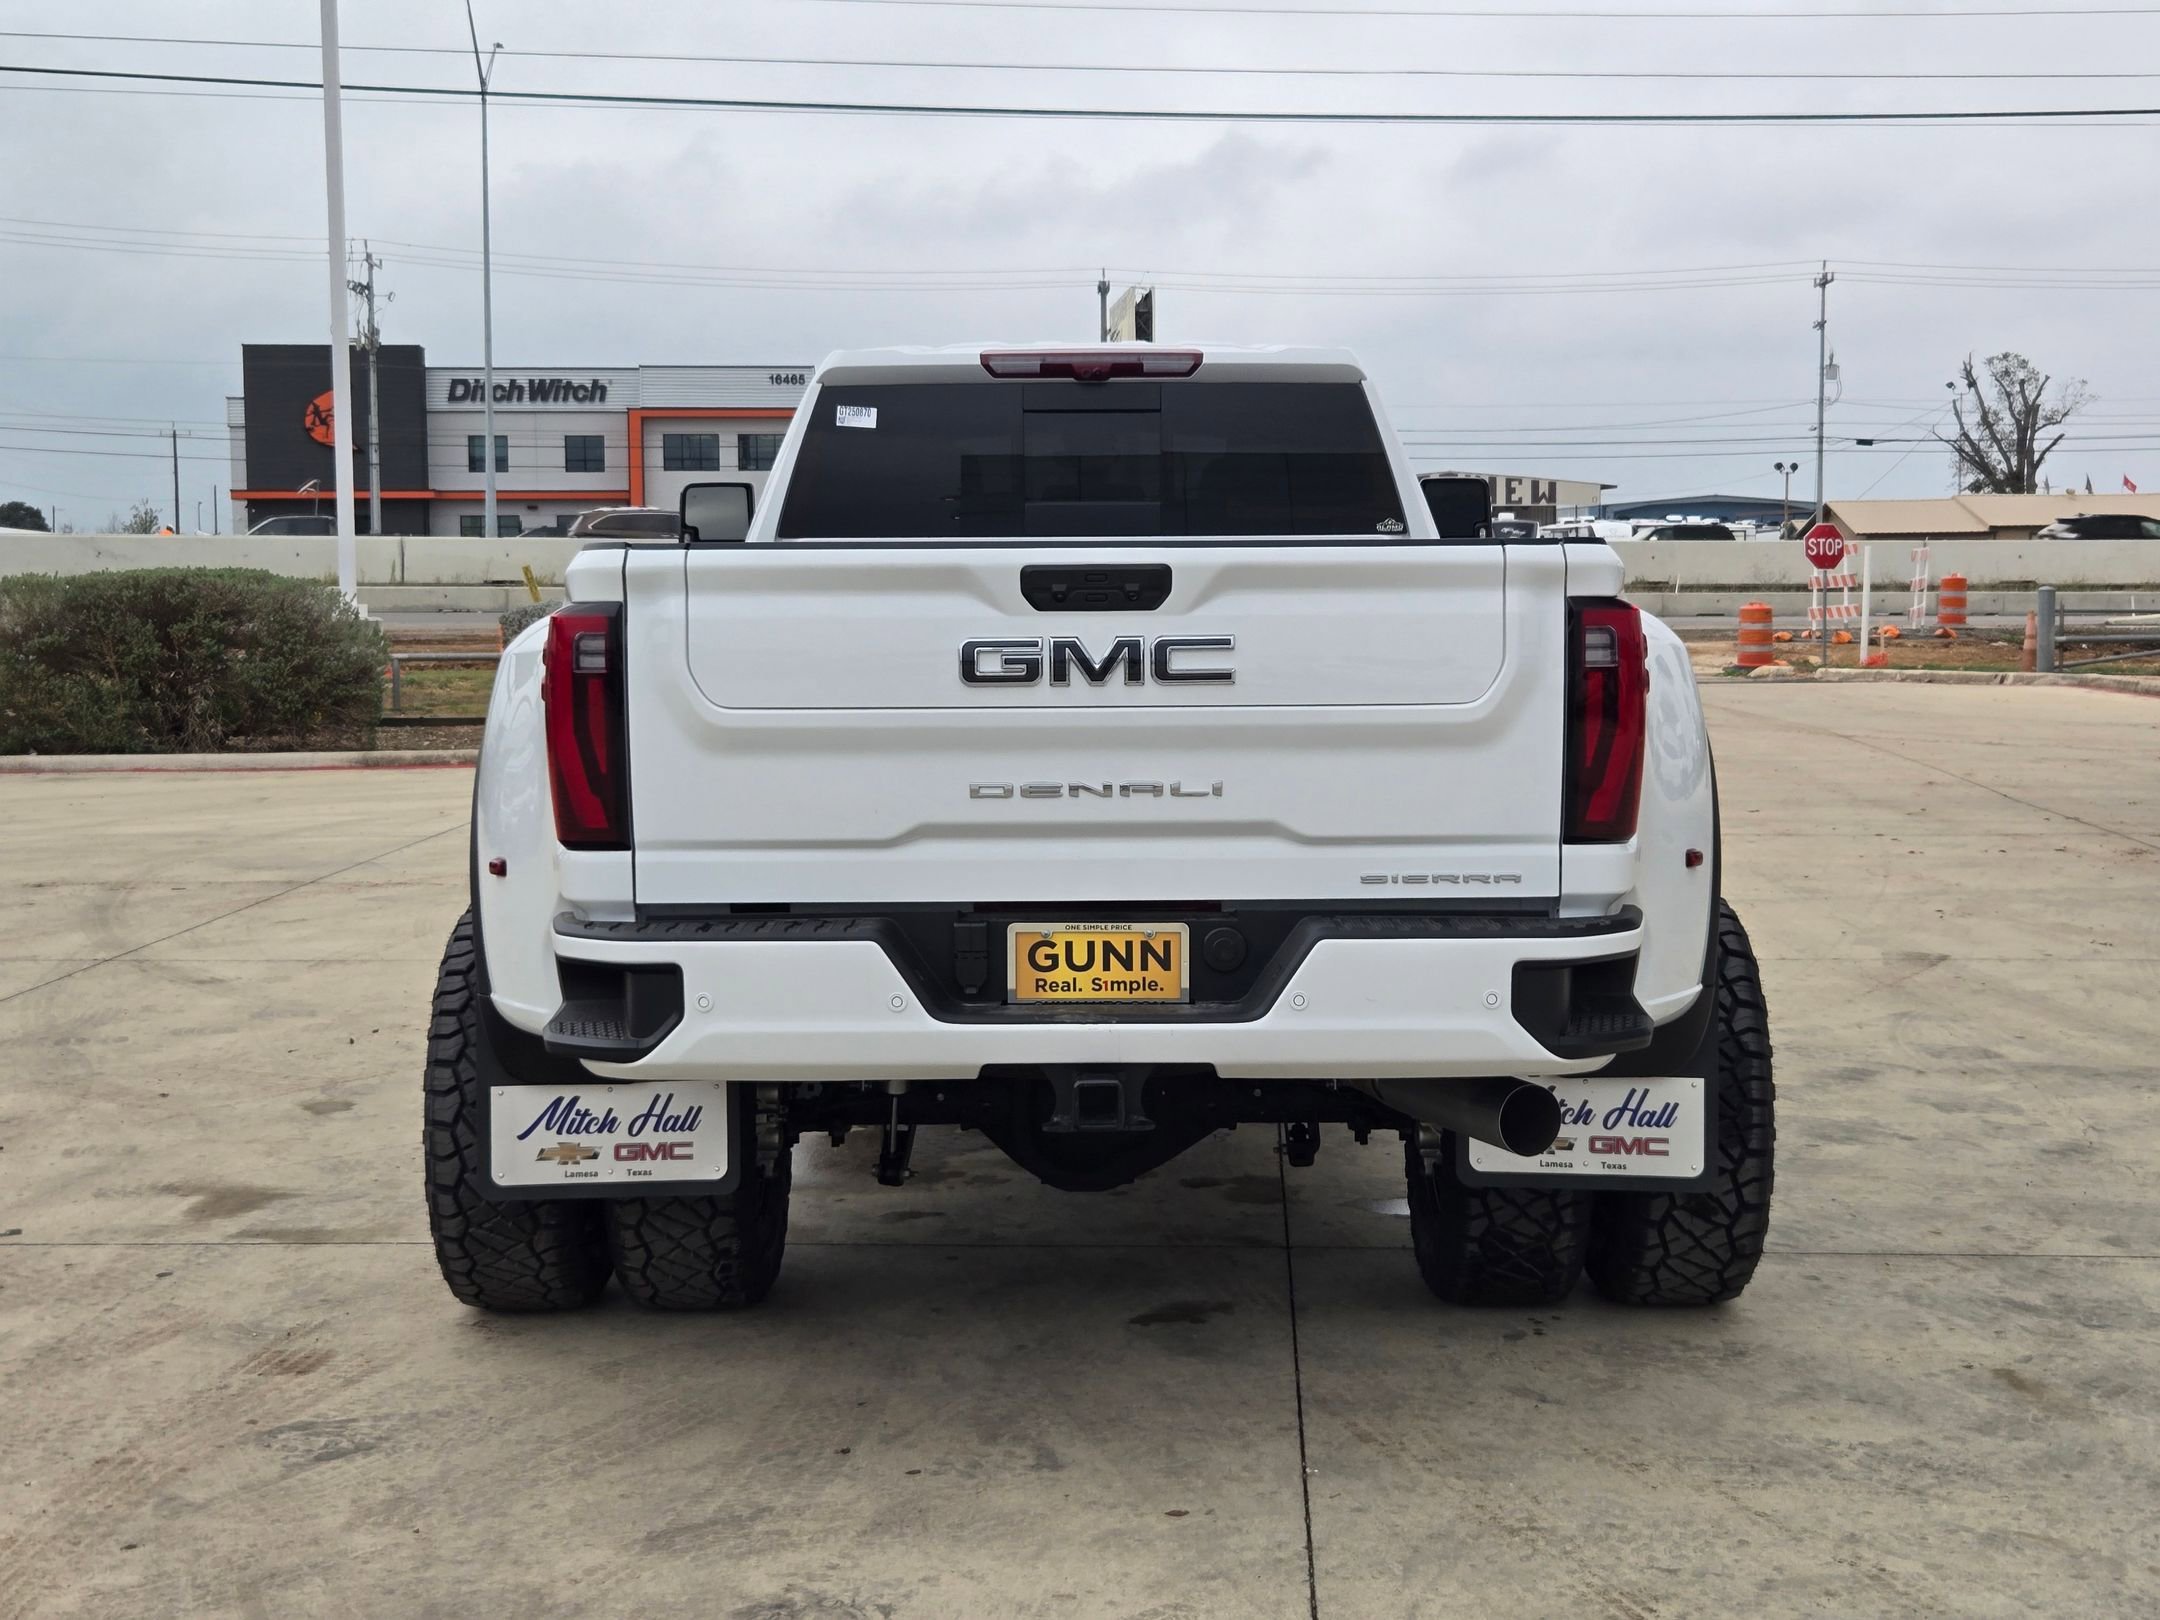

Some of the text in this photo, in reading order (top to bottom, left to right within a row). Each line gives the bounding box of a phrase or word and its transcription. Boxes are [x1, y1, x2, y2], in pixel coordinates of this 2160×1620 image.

[528, 378, 608, 403] Witch
[1807, 537, 1843, 556] STOP
[958, 633, 1236, 687] GMC
[969, 779, 1223, 799] DENALI
[1360, 873, 1522, 884] SIERRA
[1027, 940, 1172, 973] GUNN
[1035, 977, 1083, 992] Real.
[516, 1092, 704, 1141] Mitch Hall
[1602, 1087, 1680, 1131] Hall
[613, 1141, 694, 1162] GMC
[1588, 1135, 1670, 1157] GMC
[564, 1168, 653, 1179] Lamesa Texas
[1539, 1160, 1627, 1170] Lamesa Texas
